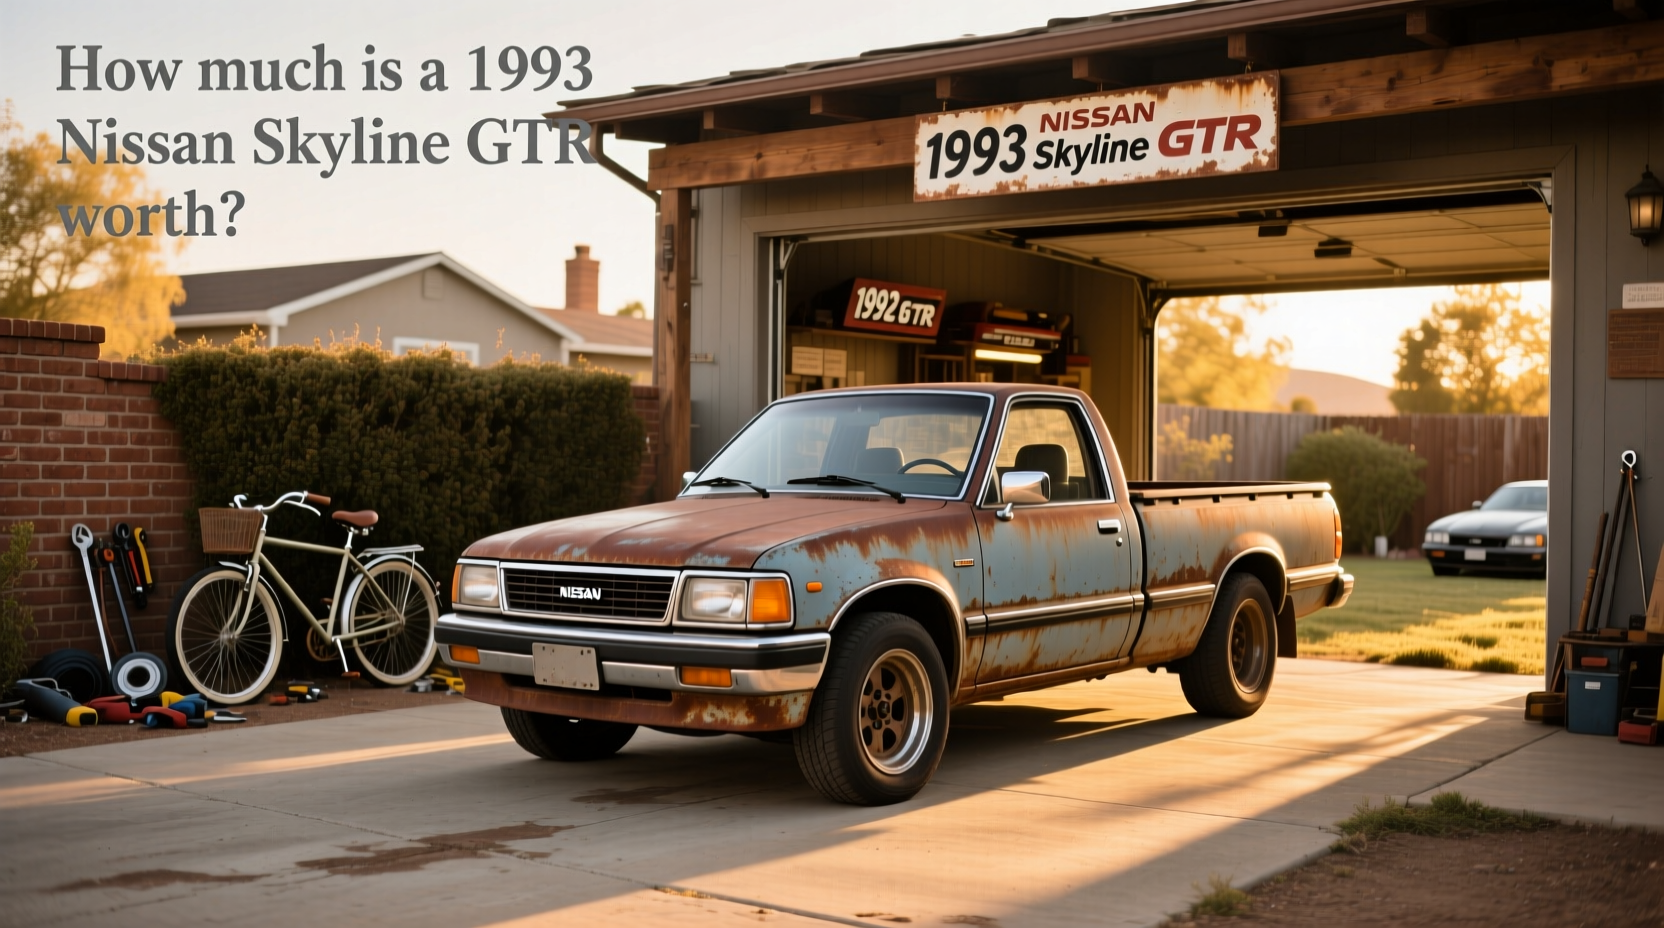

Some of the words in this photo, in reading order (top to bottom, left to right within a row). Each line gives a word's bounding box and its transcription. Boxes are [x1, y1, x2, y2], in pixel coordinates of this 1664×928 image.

[1039, 101, 1156, 133] NISSAN
[926, 124, 1028, 180] 1993
[1033, 132, 1150, 176] Skyline
[1158, 114, 1262, 158] GTR
[854, 287, 900, 322] 1992
[898, 300, 935, 328] GTR
